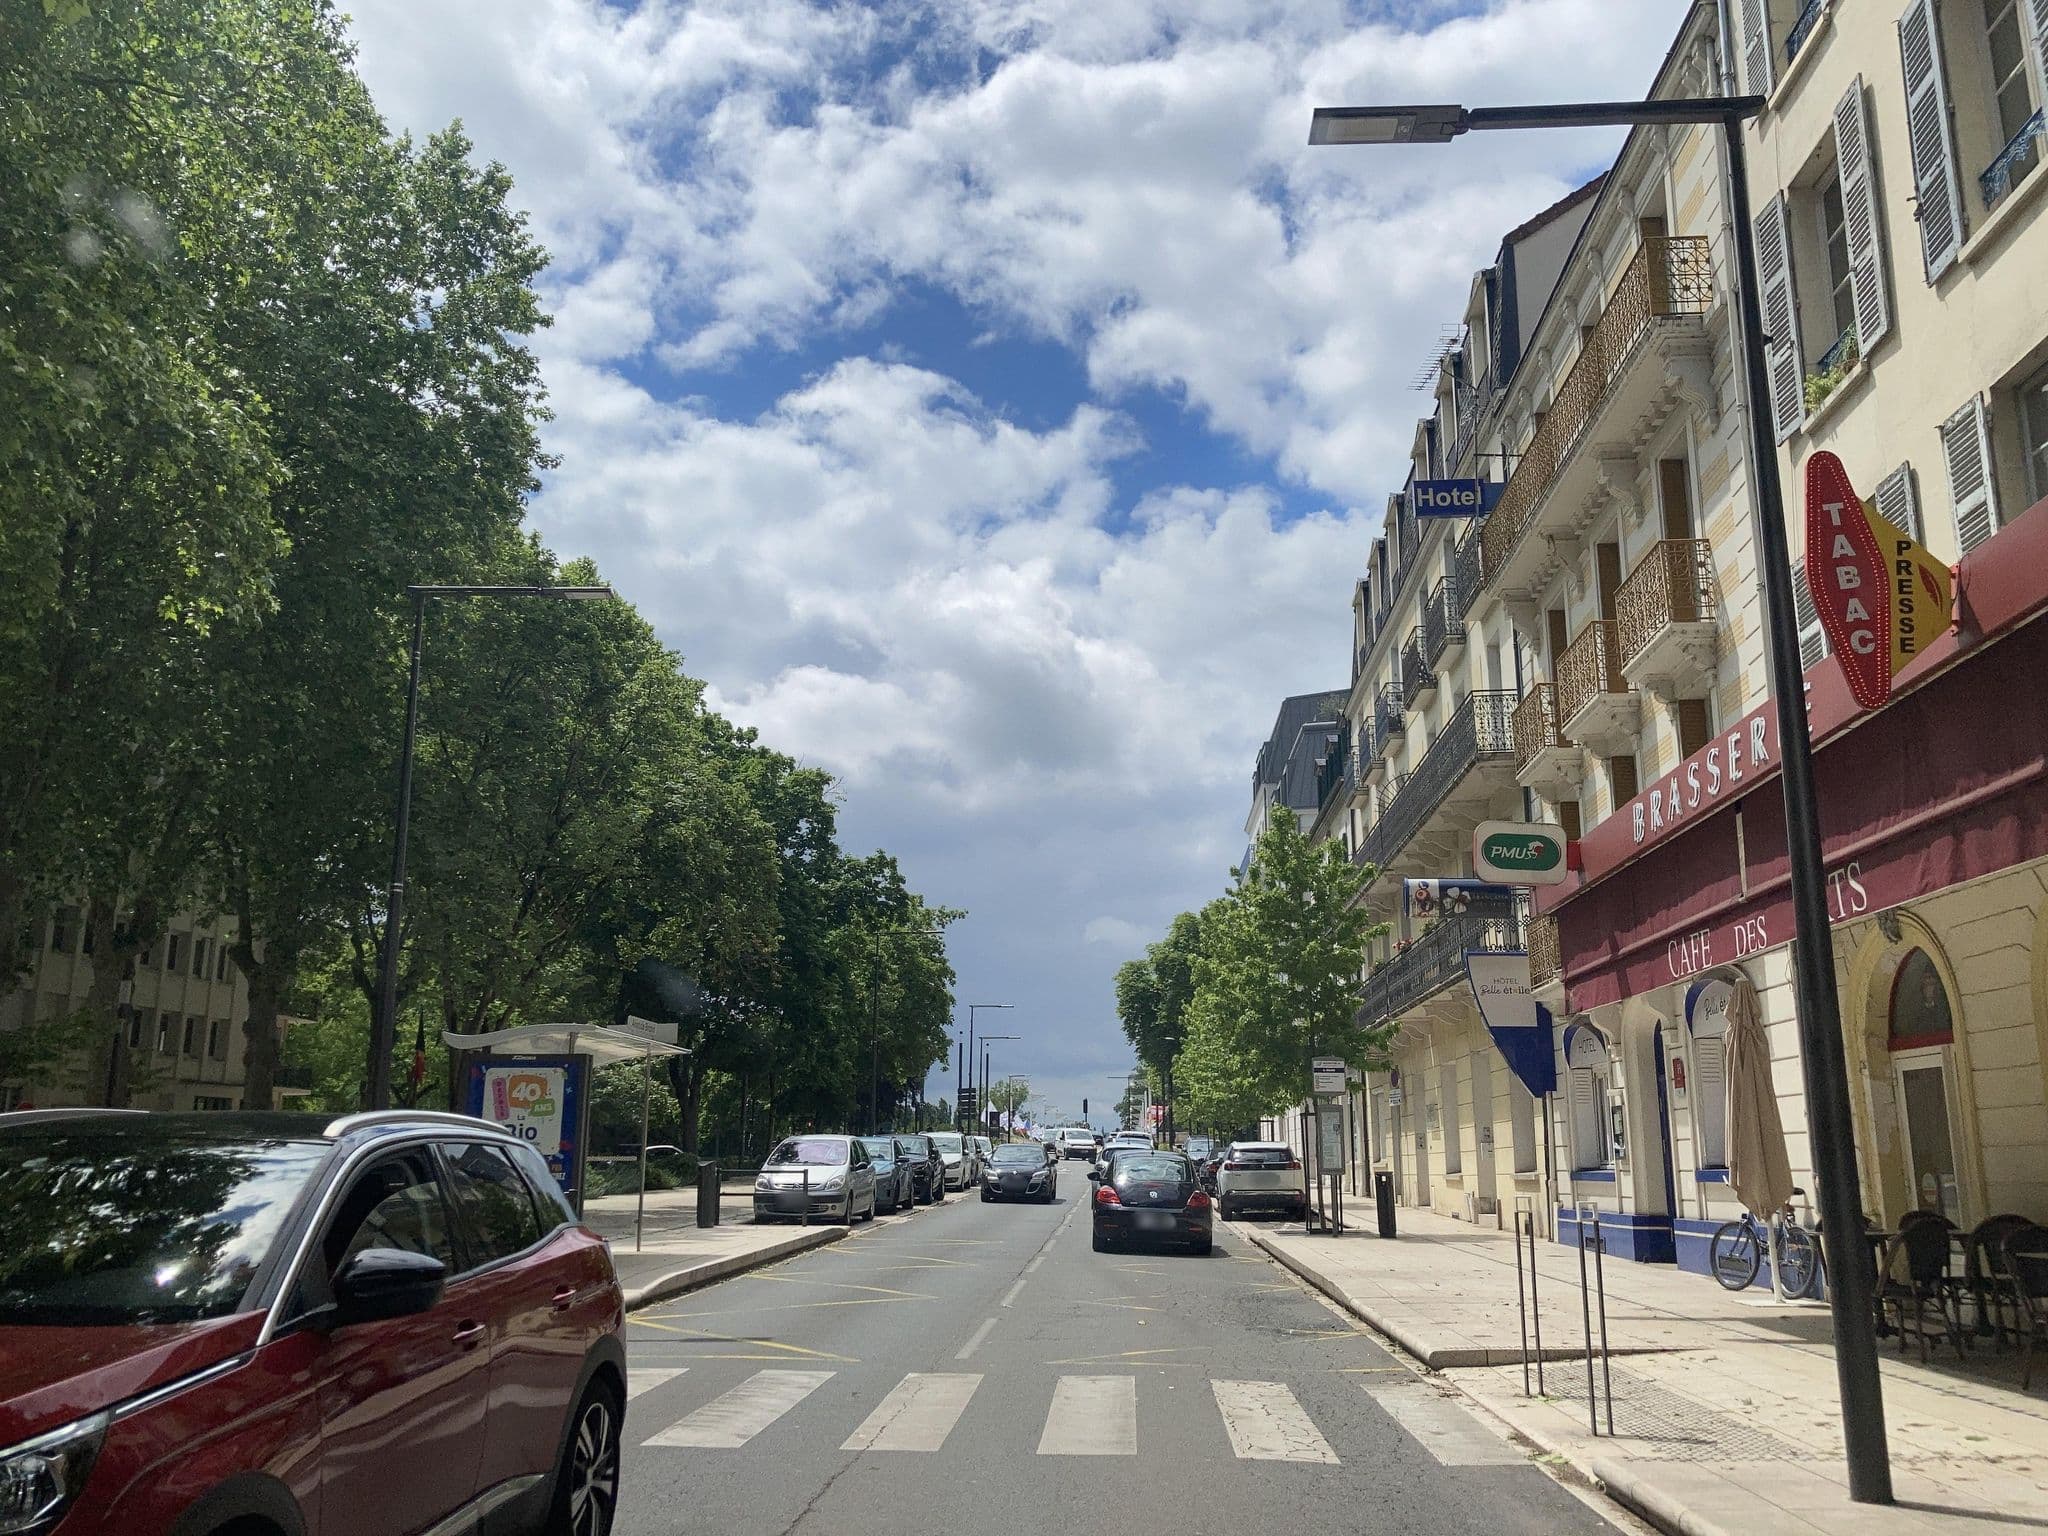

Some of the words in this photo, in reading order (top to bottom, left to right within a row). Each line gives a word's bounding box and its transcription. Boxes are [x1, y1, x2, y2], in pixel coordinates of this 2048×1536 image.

[1416, 486, 1482, 507] Hotel
[1822, 502, 1876, 655] TABAC
[1896, 540, 1916, 654] PRESSE
[1632, 681, 1813, 843] BRASSER
[1490, 845, 1527, 860] PMU
[1667, 928, 1713, 979] CAFE
[1734, 915, 1768, 958] DES
[1827, 862, 1868, 922] TS
[1479, 984, 1502, 996] Belle
[511, 1081, 542, 1102] 40
[534, 1103, 553, 1112] ANS
